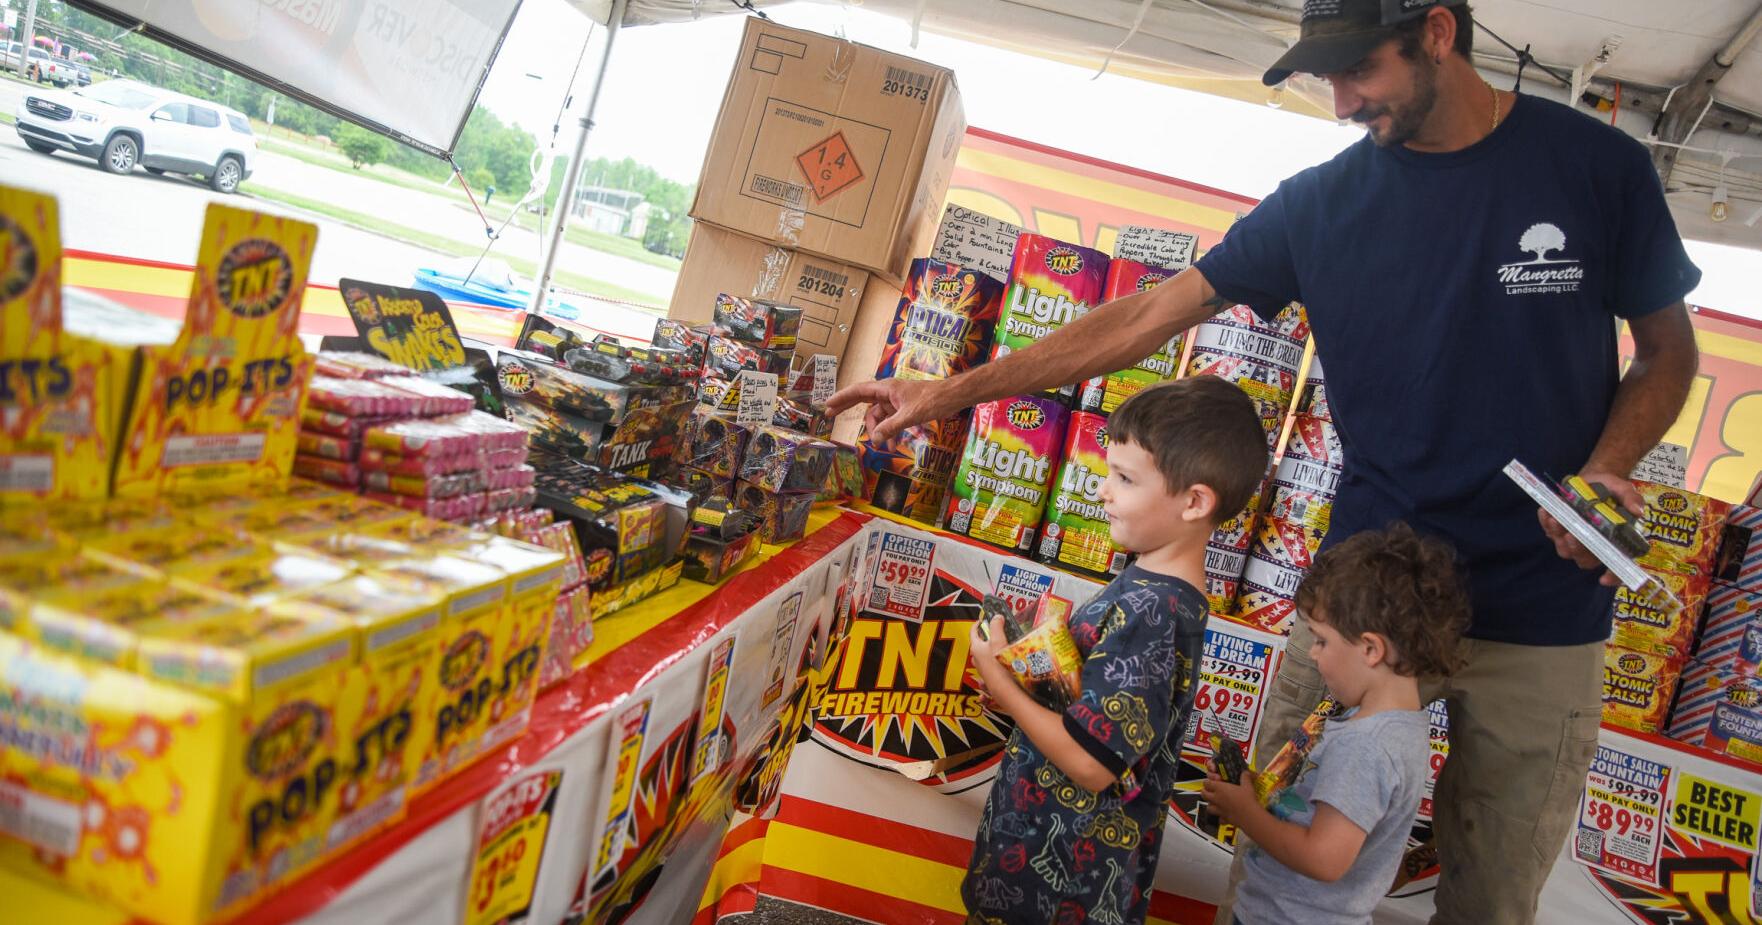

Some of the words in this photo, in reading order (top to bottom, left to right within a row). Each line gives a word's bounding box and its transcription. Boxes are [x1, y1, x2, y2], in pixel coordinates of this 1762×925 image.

[882, 79, 930, 102] 201373
[818, 146, 847, 170] 1.4
[821, 169, 832, 180] G
[953, 207, 989, 226] Optical
[997, 221, 1020, 236] Illus
[1052, 256, 1078, 270] TNT
[230, 256, 284, 301] TNT
[938, 281, 958, 292] TNT
[1498, 266, 1583, 285] Mangretta
[798, 275, 844, 299] 201204
[1506, 285, 1562, 294] Landscaping
[1011, 282, 1089, 324] Light
[1218, 329, 1255, 354] LIVING
[1256, 338, 1277, 358] THE
[167, 354, 294, 414] POP-ITS
[504, 372, 529, 388] TNT
[1013, 409, 1038, 423] TNT
[609, 440, 653, 470] TANK
[973, 439, 1050, 484] Light
[1062, 463, 1107, 502] Lig
[1292, 463, 1328, 487] LIVING
[966, 470, 1042, 505] Symphony
[1055, 494, 1104, 520] Symph
[1643, 505, 1697, 532] ATOMIC
[888, 534, 931, 551] OPTICAL
[1642, 523, 1689, 545] SALSA
[884, 542, 931, 559] ILLUSION
[886, 553, 899, 561] YOU
[900, 555, 911, 563] PAY
[910, 558, 926, 566] ONLY
[1016, 567, 1042, 582] LIGHT
[1221, 555, 1241, 575] DREA
[1001, 574, 1051, 593] SYMPHONY
[1275, 570, 1300, 592] LIVI
[1618, 603, 1666, 625] SALSA
[1211, 632, 1254, 653] LIVING
[836, 619, 977, 691] TNT
[1203, 643, 1216, 657] HE
[1220, 647, 1266, 670] DREAM
[1211, 660, 1260, 683] $79.99
[1200, 673, 1210, 682] OU
[1213, 677, 1230, 687] PAY
[1233, 682, 1257, 693] ONLY
[819, 690, 984, 718] FIREWORKS
[1602, 686, 1646, 706] SALSA
[1228, 712, 1248, 722] EACH
[1718, 708, 1762, 730] CENTEN
[1719, 719, 1762, 740] FOUNTA
[1589, 759, 1661, 788] FOUNTAIN
[1631, 757, 1659, 775] SALSA
[1589, 774, 1606, 785] was
[1607, 778, 1659, 804] $99.99
[1690, 781, 1748, 817] BEST
[1590, 789, 1610, 801] YOU
[1611, 795, 1630, 807] PAY
[1632, 802, 1656, 815] ONLY
[1675, 803, 1754, 846] SELLER
[1631, 833, 1651, 845] EACH
